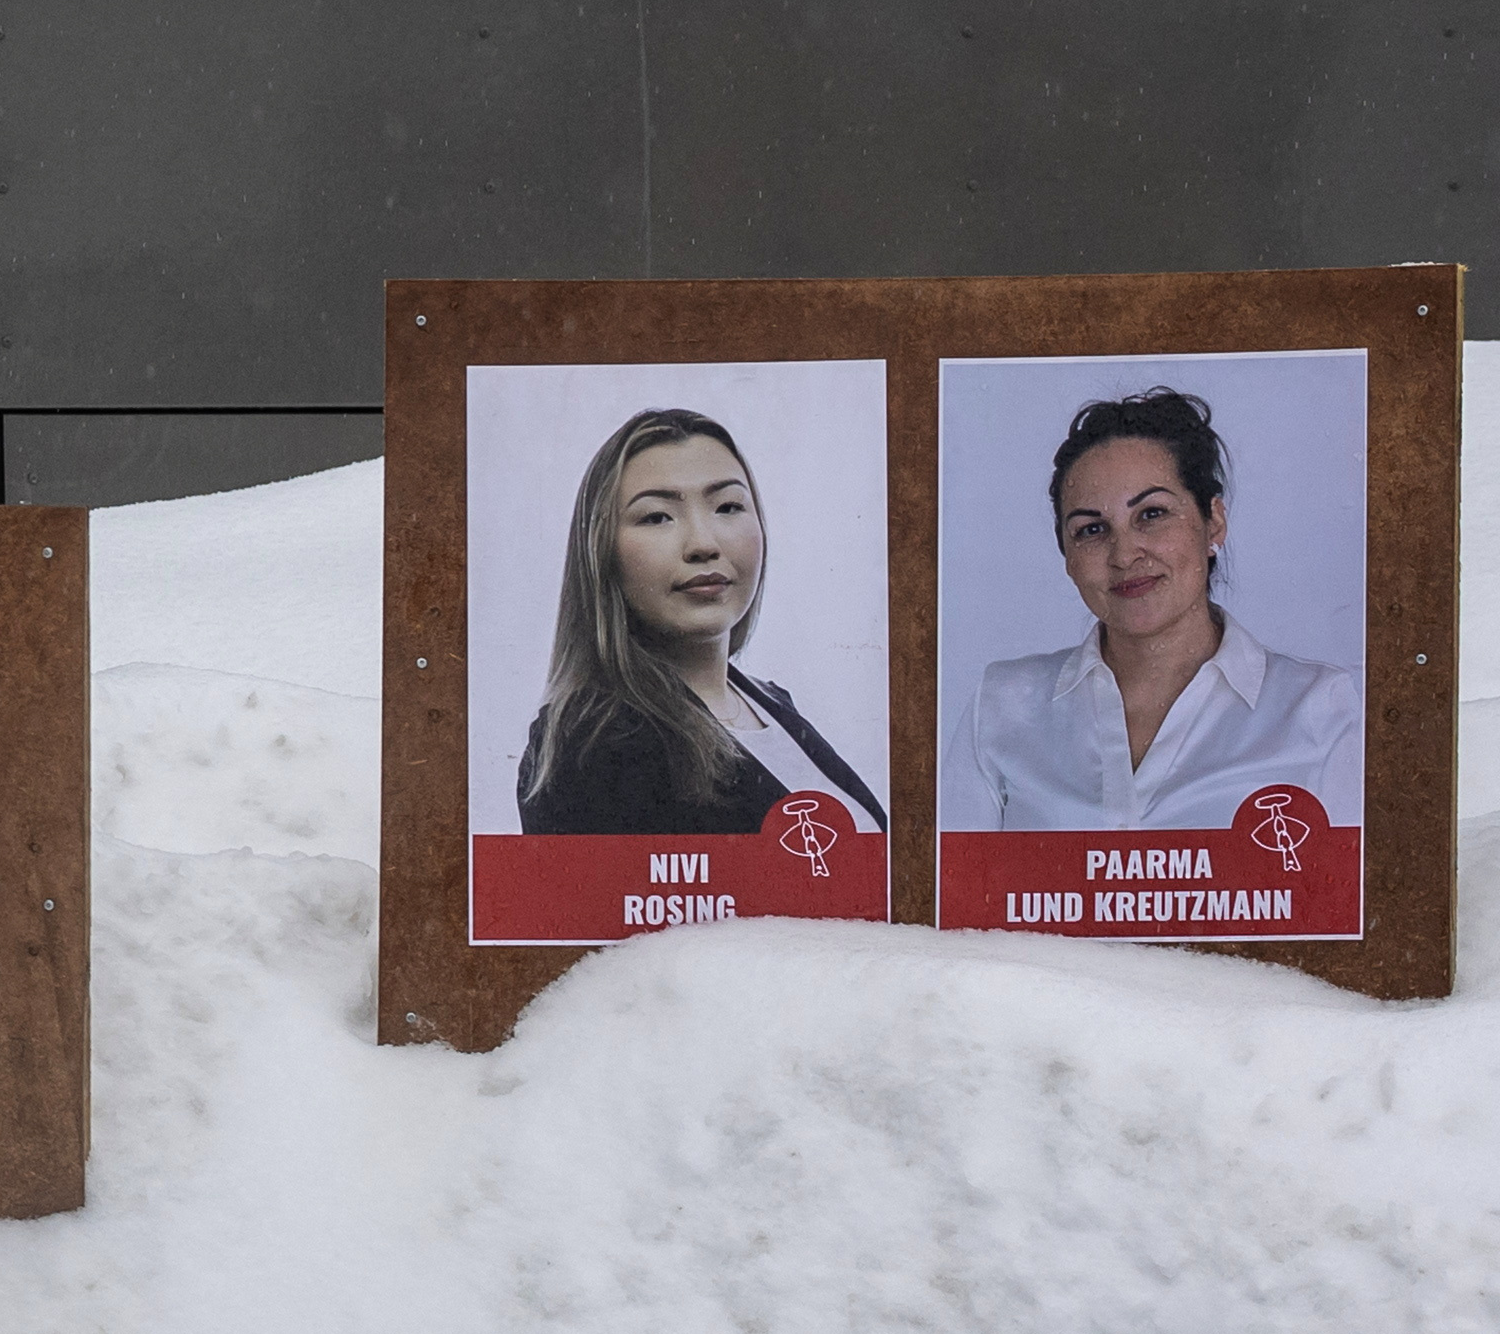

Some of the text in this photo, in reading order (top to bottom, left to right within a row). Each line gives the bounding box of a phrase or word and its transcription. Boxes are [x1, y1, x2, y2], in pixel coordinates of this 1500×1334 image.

[650, 853, 709, 884] NIVI
[1086, 848, 1213, 880] PAARMA
[624, 894, 736, 925] ROSING
[1006, 889, 1292, 923] LUND KREUTZMANN
